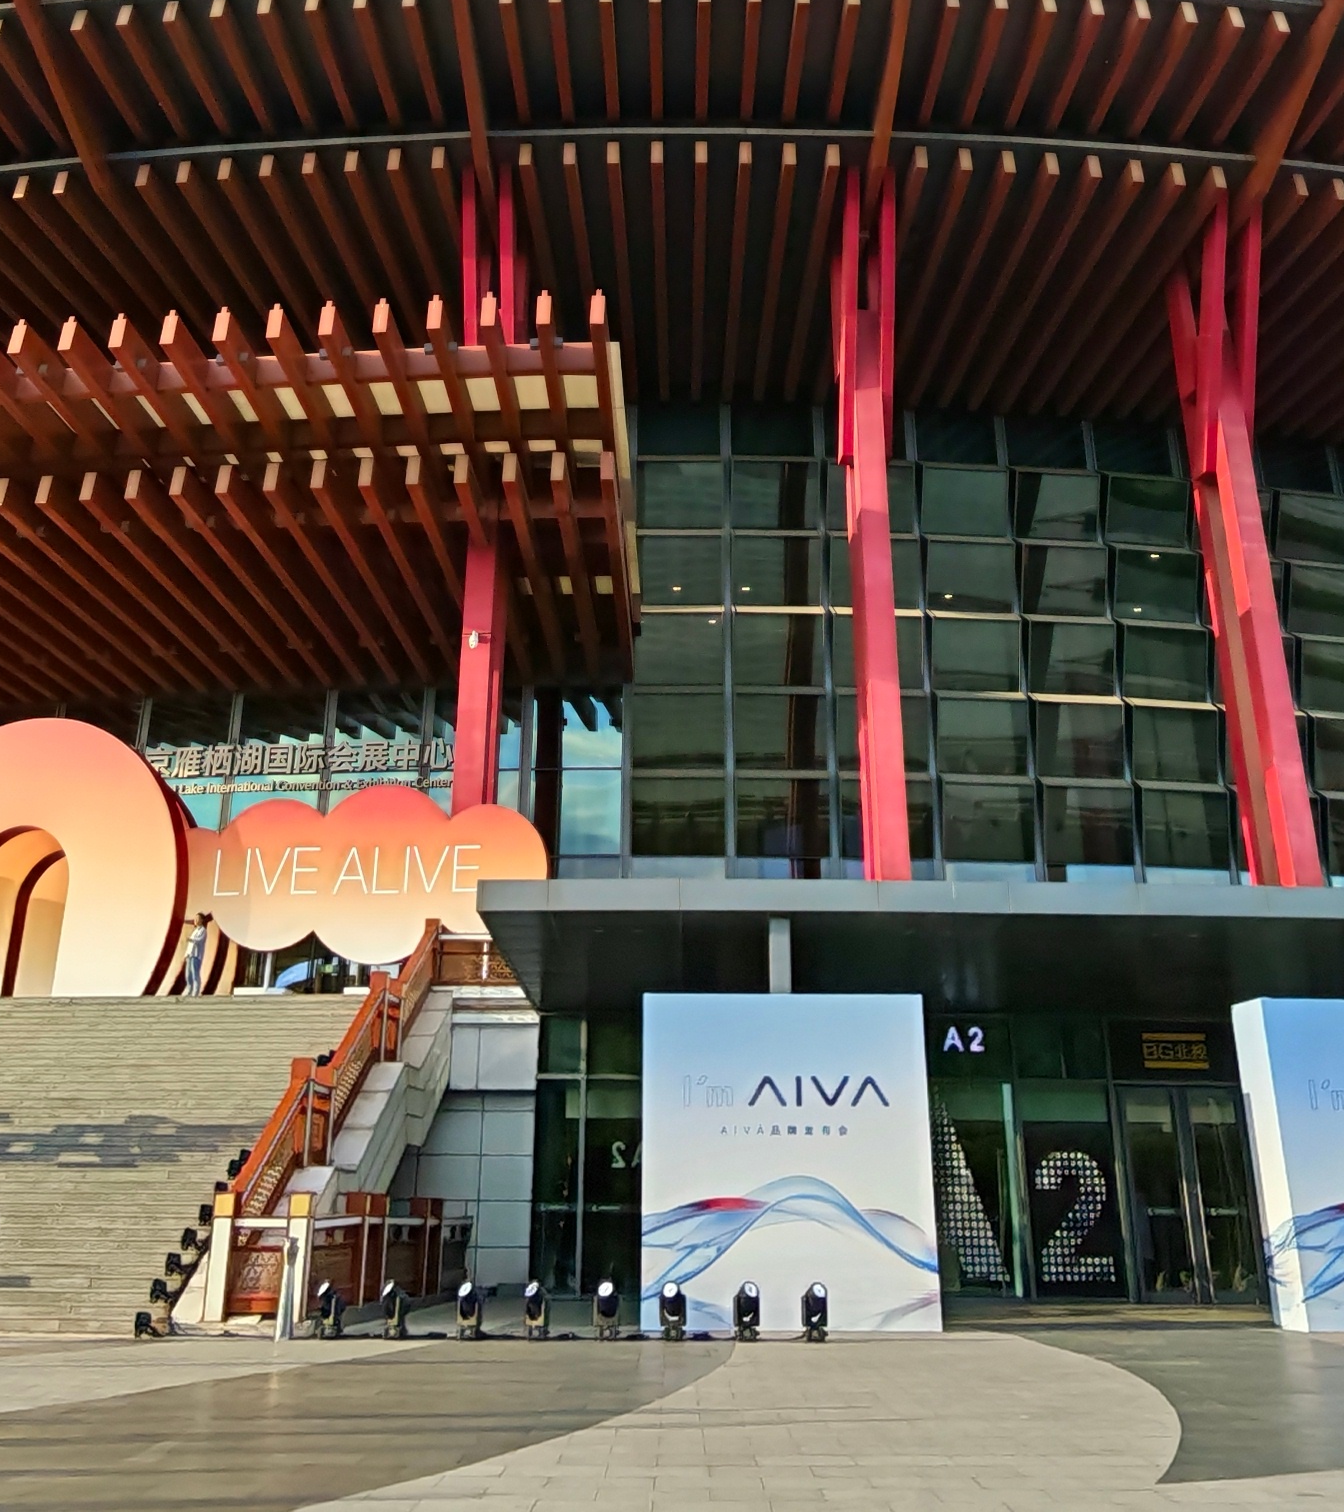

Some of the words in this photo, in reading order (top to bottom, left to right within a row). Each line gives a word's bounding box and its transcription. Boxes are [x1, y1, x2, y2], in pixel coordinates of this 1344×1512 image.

[179, 782, 204, 795] Lake
[206, 779, 273, 794] International
[277, 777, 340, 791] Convention
[415, 776, 453, 788] Center
[212, 846, 322, 897] LIVE
[332, 844, 482, 895] ALIVE
[943, 1026, 986, 1052] A2
[748, 1075, 890, 1107] AIVA
